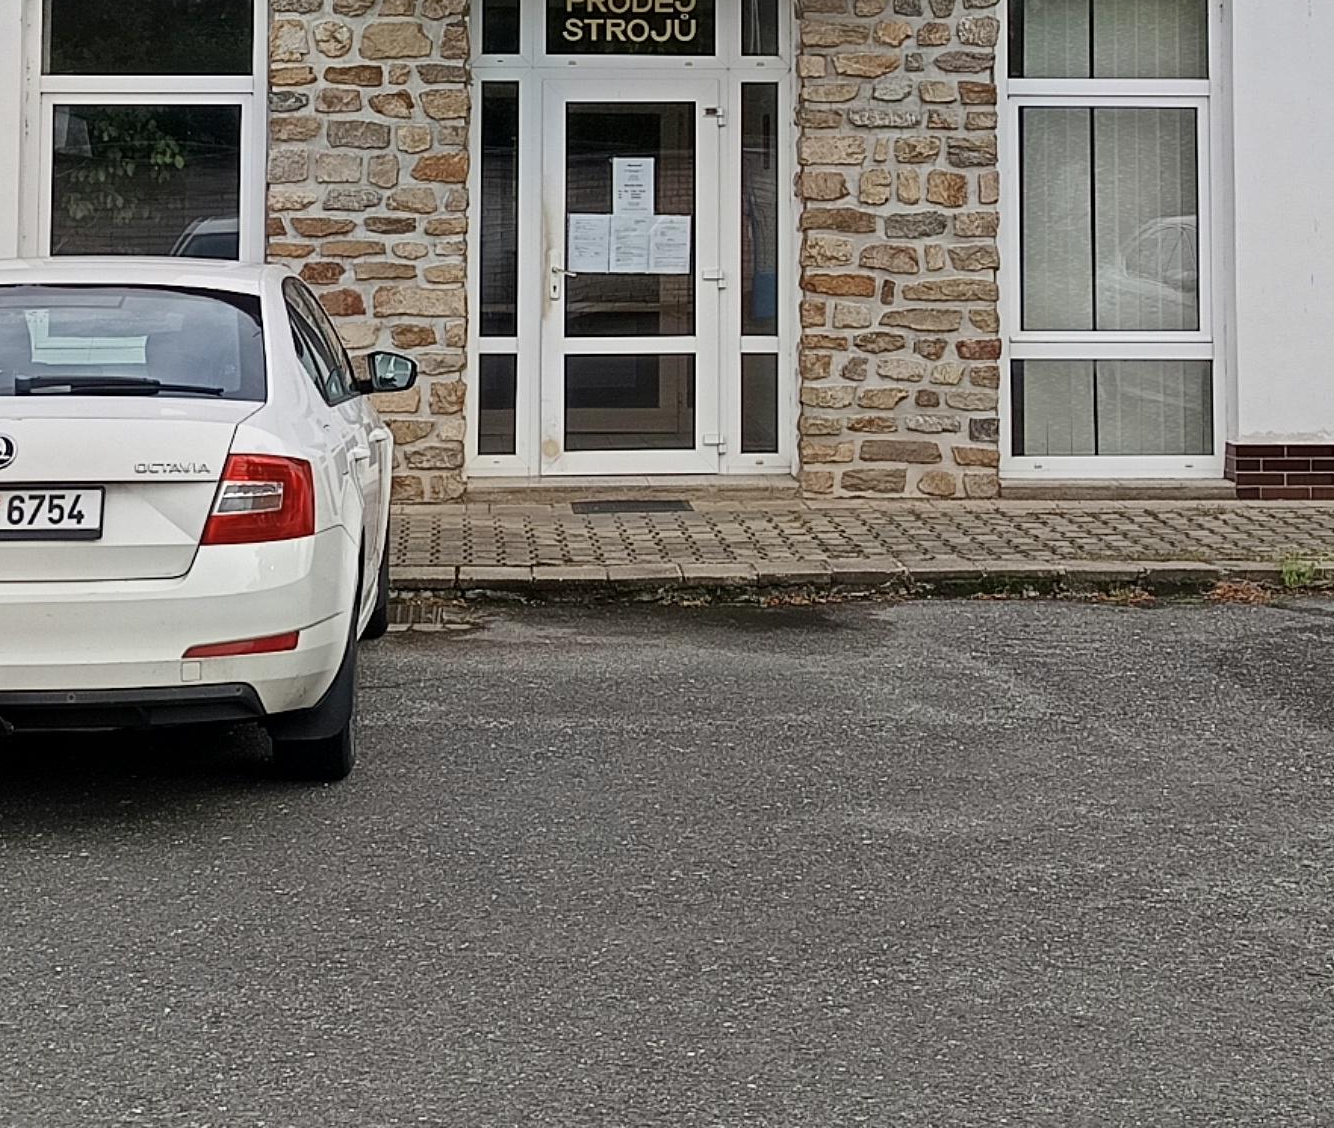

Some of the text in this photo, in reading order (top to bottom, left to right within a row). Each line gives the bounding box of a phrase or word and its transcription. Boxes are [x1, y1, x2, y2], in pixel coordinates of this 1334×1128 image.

[562, 13, 697, 42] STROJŮ
[134, 463, 211, 474] OCTAVIA
[7, 494, 85, 526] 6754
